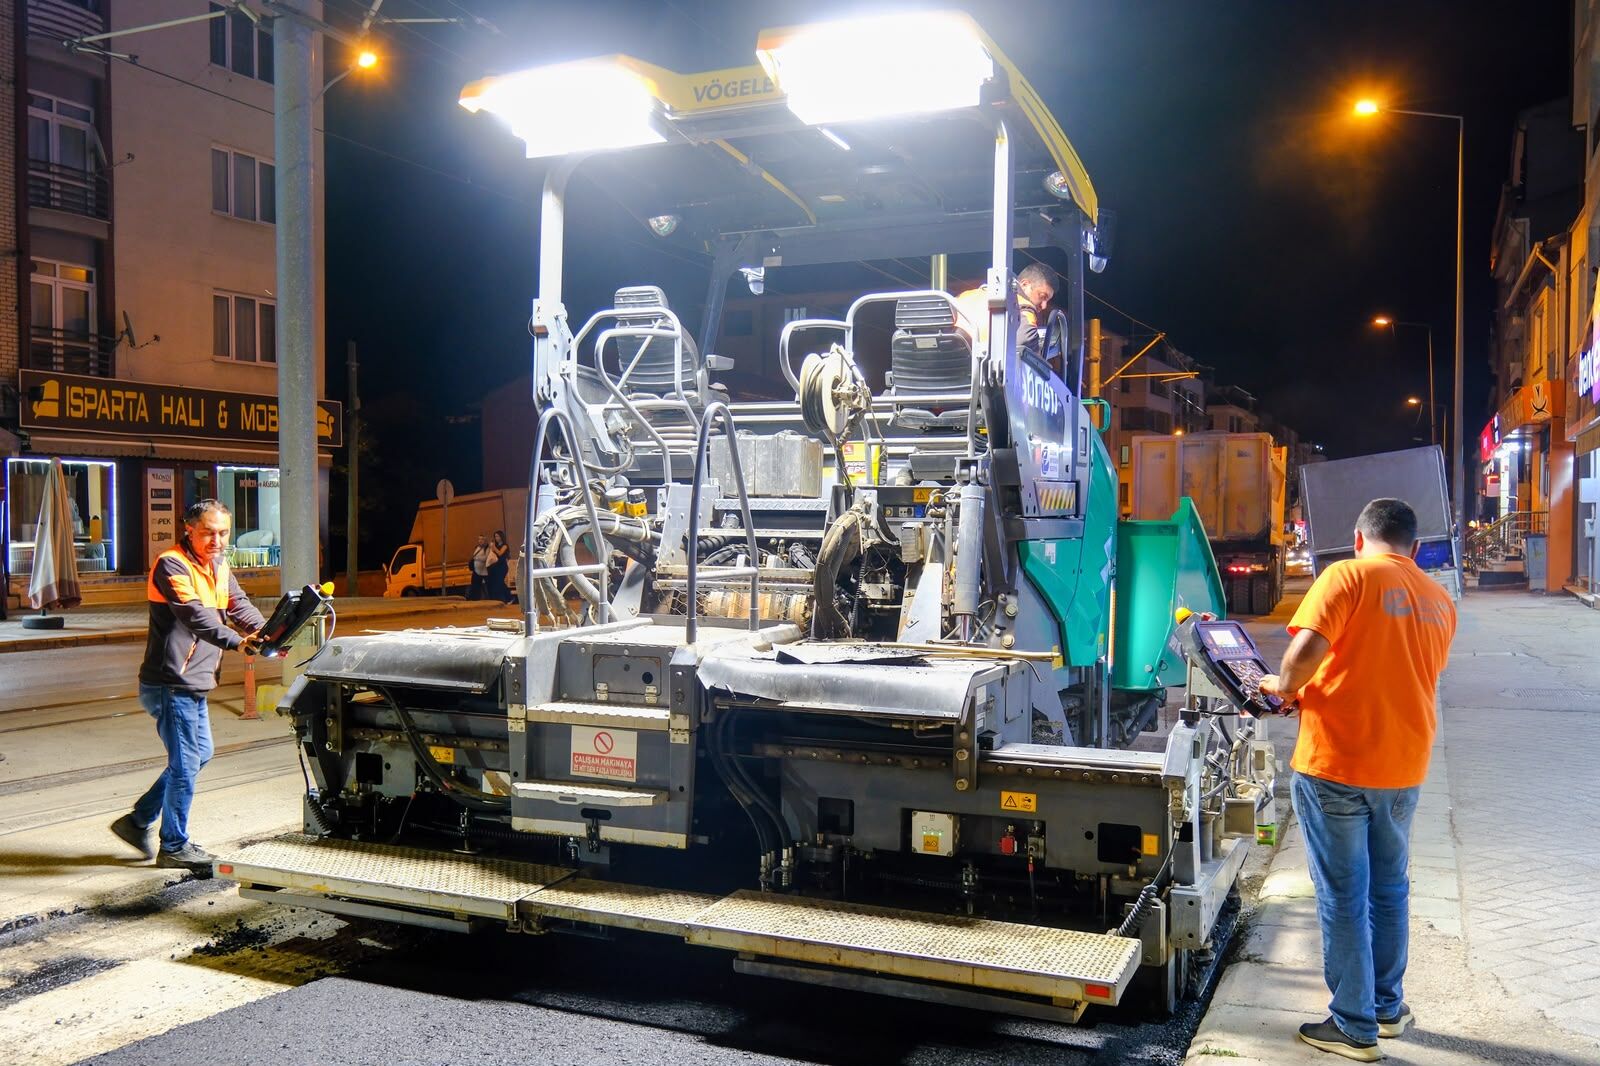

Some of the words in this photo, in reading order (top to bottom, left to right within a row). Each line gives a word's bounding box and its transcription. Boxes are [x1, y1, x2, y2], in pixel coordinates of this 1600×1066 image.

[66, 386, 149, 422] ISPARTA
[161, 395, 204, 427] HALI
[218, 400, 228, 429] &
[240, 403, 279, 431] MOB
[574, 755, 600, 765] ÇALIŞAN
